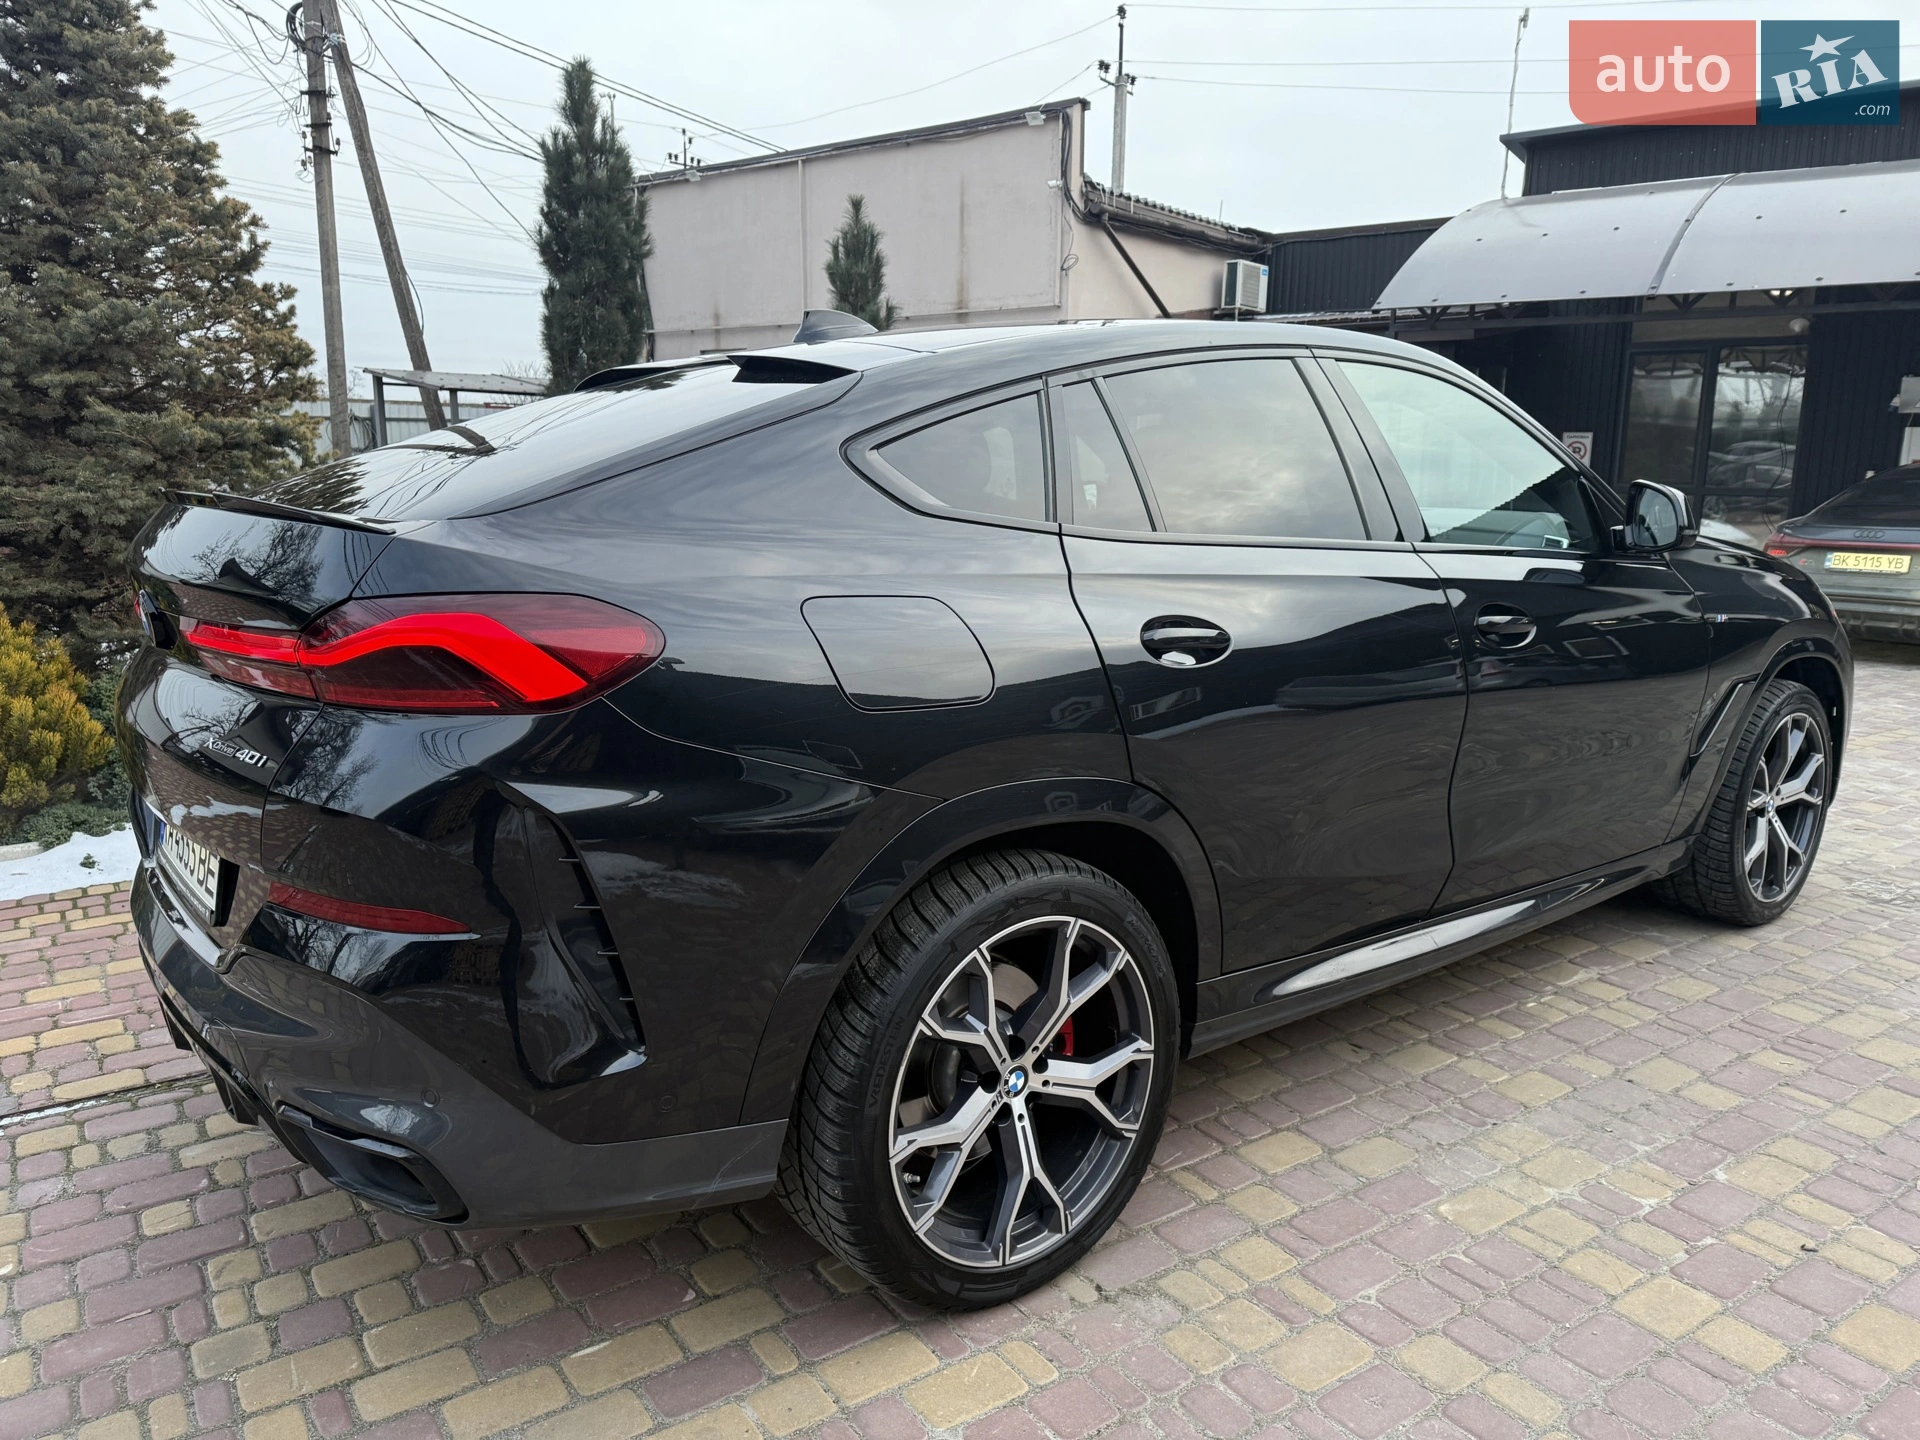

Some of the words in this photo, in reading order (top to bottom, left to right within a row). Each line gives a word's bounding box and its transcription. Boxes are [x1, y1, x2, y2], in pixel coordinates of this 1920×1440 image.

[1832, 555, 1851, 567] BK
[1853, 555, 1882, 568] 5115
[1887, 557, 1904, 569] YB
[197, 845, 217, 899] BE
